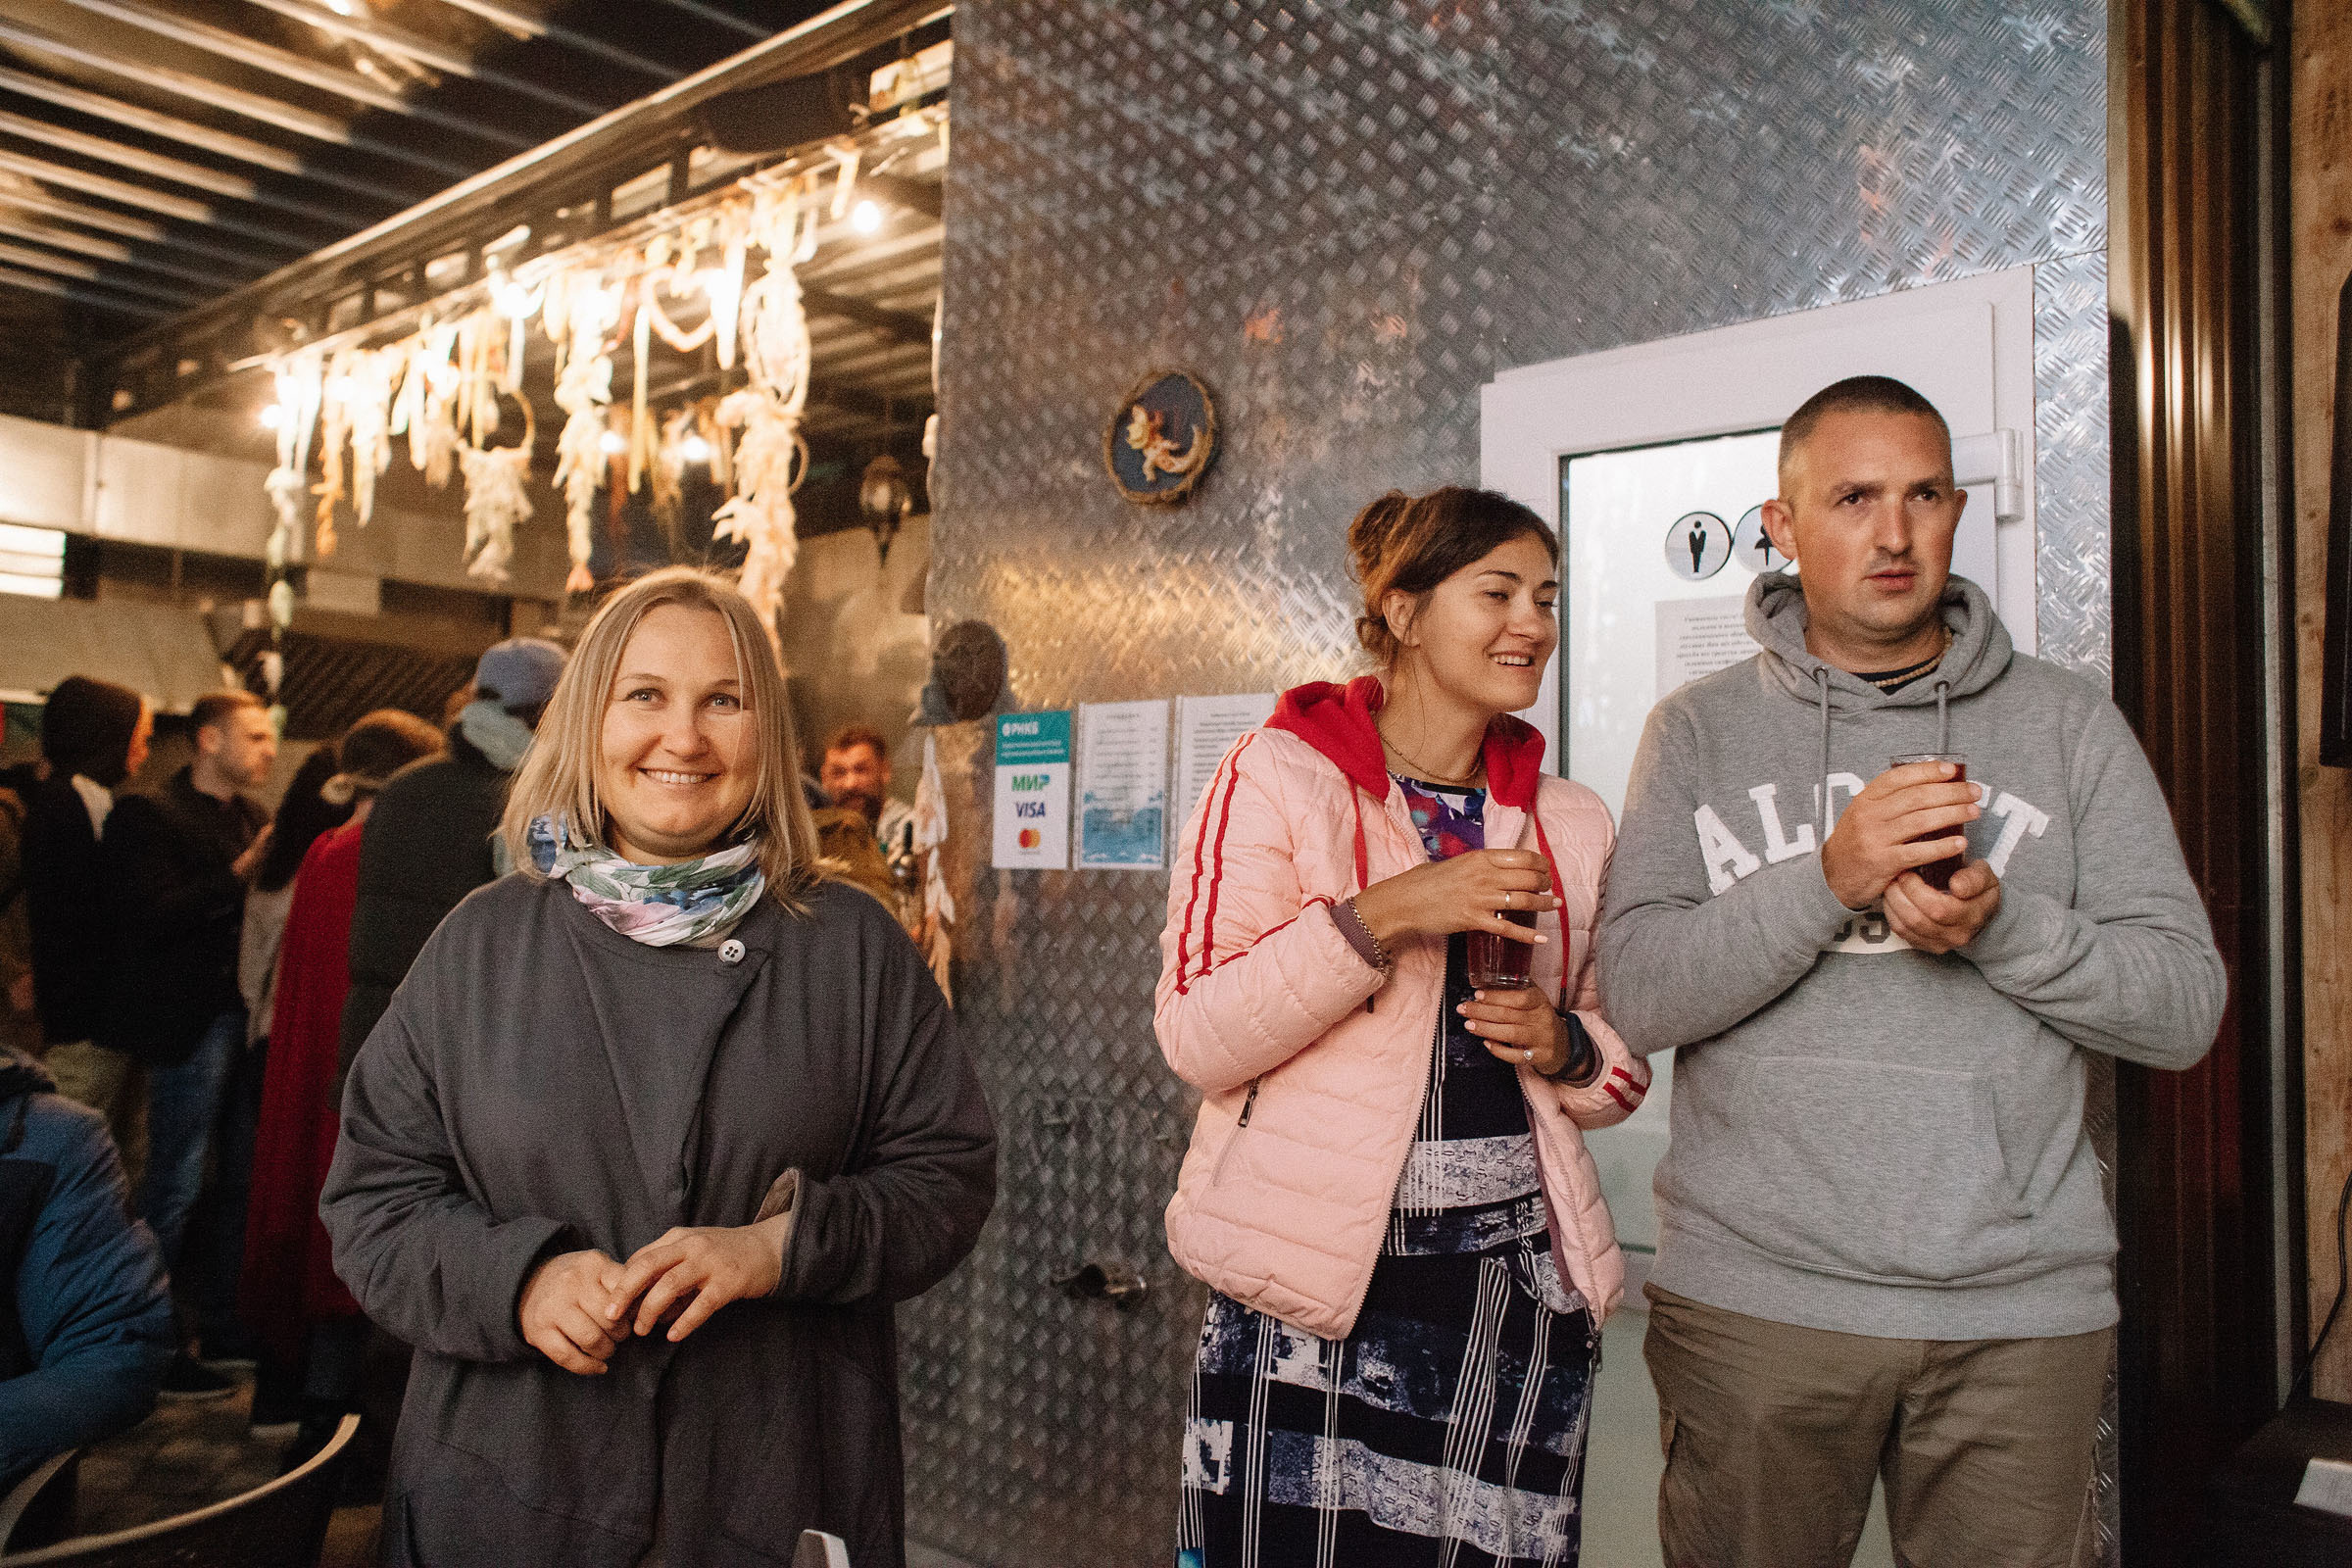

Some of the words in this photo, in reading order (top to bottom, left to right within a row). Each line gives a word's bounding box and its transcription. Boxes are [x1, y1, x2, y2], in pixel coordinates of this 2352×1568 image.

[1011, 721, 1040, 736] РНКБ
[1011, 774, 1051, 792] МИР
[1014, 802, 1046, 818] VISA
